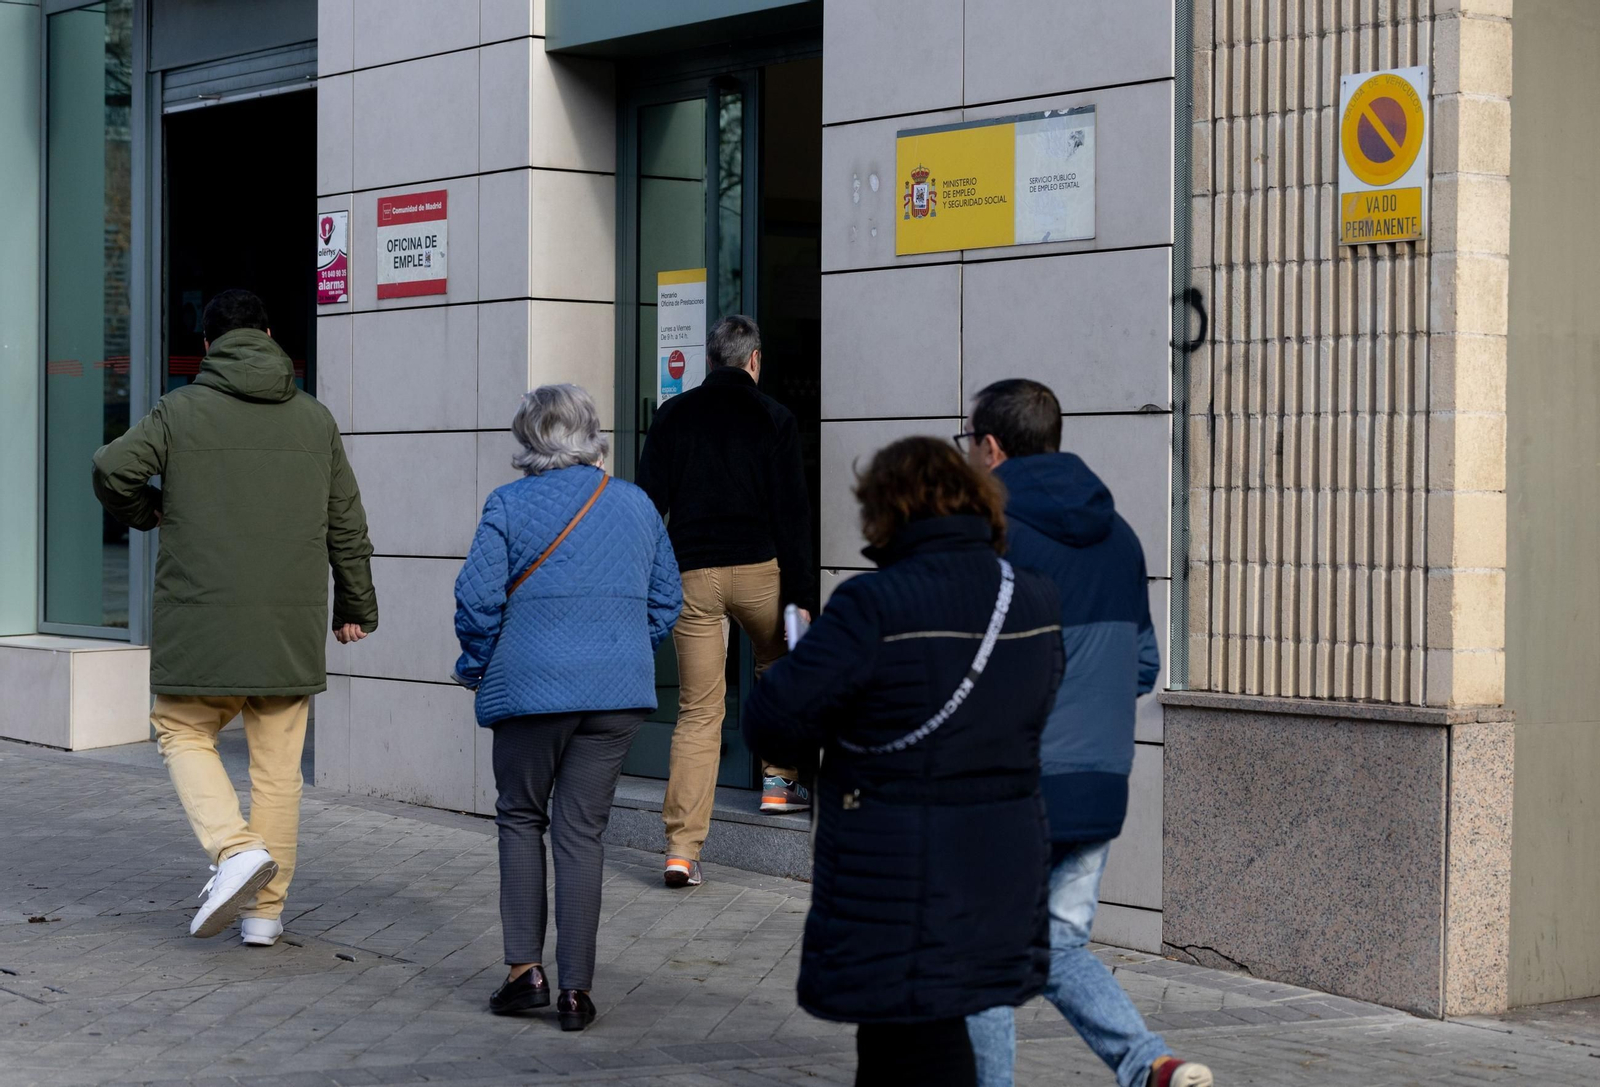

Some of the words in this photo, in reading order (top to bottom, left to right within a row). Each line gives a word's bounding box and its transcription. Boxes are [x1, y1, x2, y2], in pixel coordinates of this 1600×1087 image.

[1344, 88, 1366, 121] SALIDA
[1368, 77, 1379, 90] DE
[1385, 75, 1422, 114] VEHICULOS
[942, 177, 978, 189] MINISTERIO
[1029, 175, 1053, 185] SERVICIO
[1053, 172, 1077, 182] PÚBLICO
[942, 190, 951, 199] DE
[952, 187, 977, 198] EMPLEO
[1029, 185, 1037, 193] DE
[1037, 183, 1059, 192] EMPLEO
[1059, 181, 1080, 190] ESTATAL
[392, 205, 418, 215] Comunidad
[425, 201, 442, 210] Madrid
[942, 201, 948, 209] Y
[948, 197, 984, 209] SEGURIDAD
[984, 194, 1008, 205] SOCIAL
[1366, 194, 1397, 213] VADO
[1345, 216, 1418, 238] PERMANENTE
[386, 236, 423, 253] OFICINA
[424, 234, 437, 249] DE
[318, 279, 345, 290] alarma
[680, 298, 704, 306] Prestaciones
